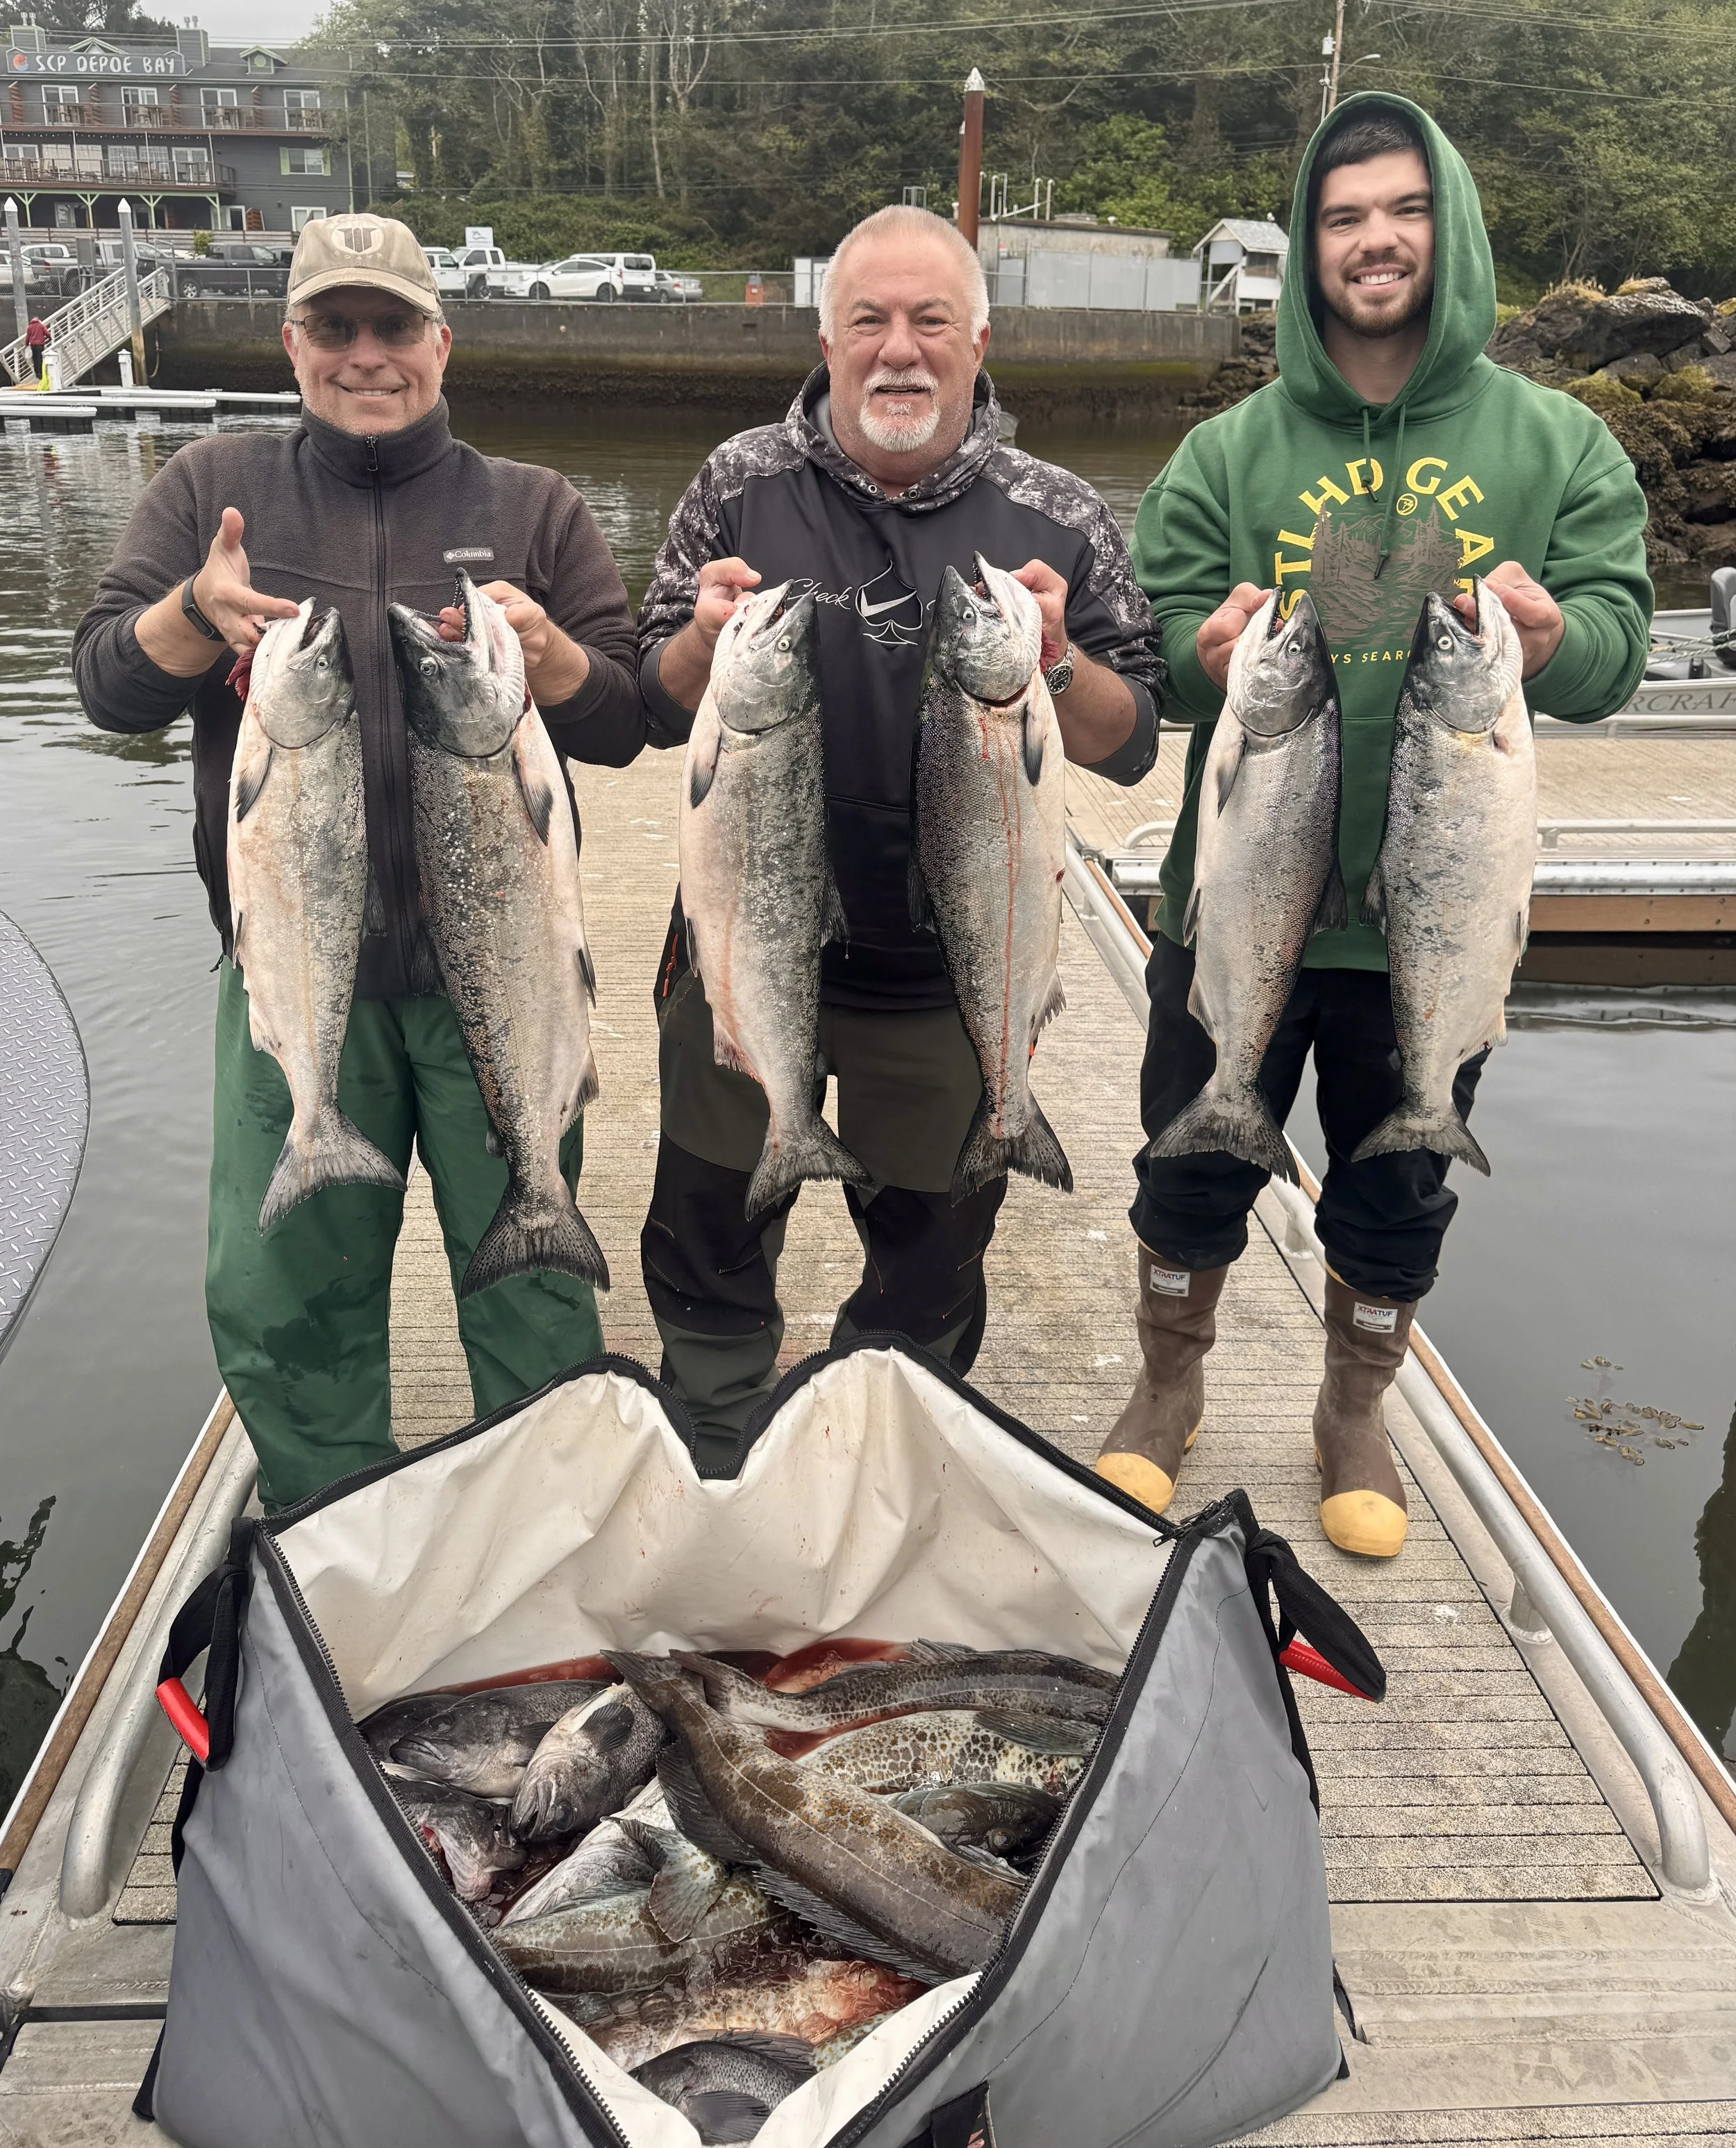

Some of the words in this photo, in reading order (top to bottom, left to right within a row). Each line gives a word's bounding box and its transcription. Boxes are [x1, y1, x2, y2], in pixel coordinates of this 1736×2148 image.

[35, 55, 67, 72] SCP
[76, 56, 132, 73] DEPOE
[142, 56, 174, 74] BAY
[1153, 1268, 1186, 1281] XTRATUF
[1358, 1305, 1393, 1317] XTRATUF
